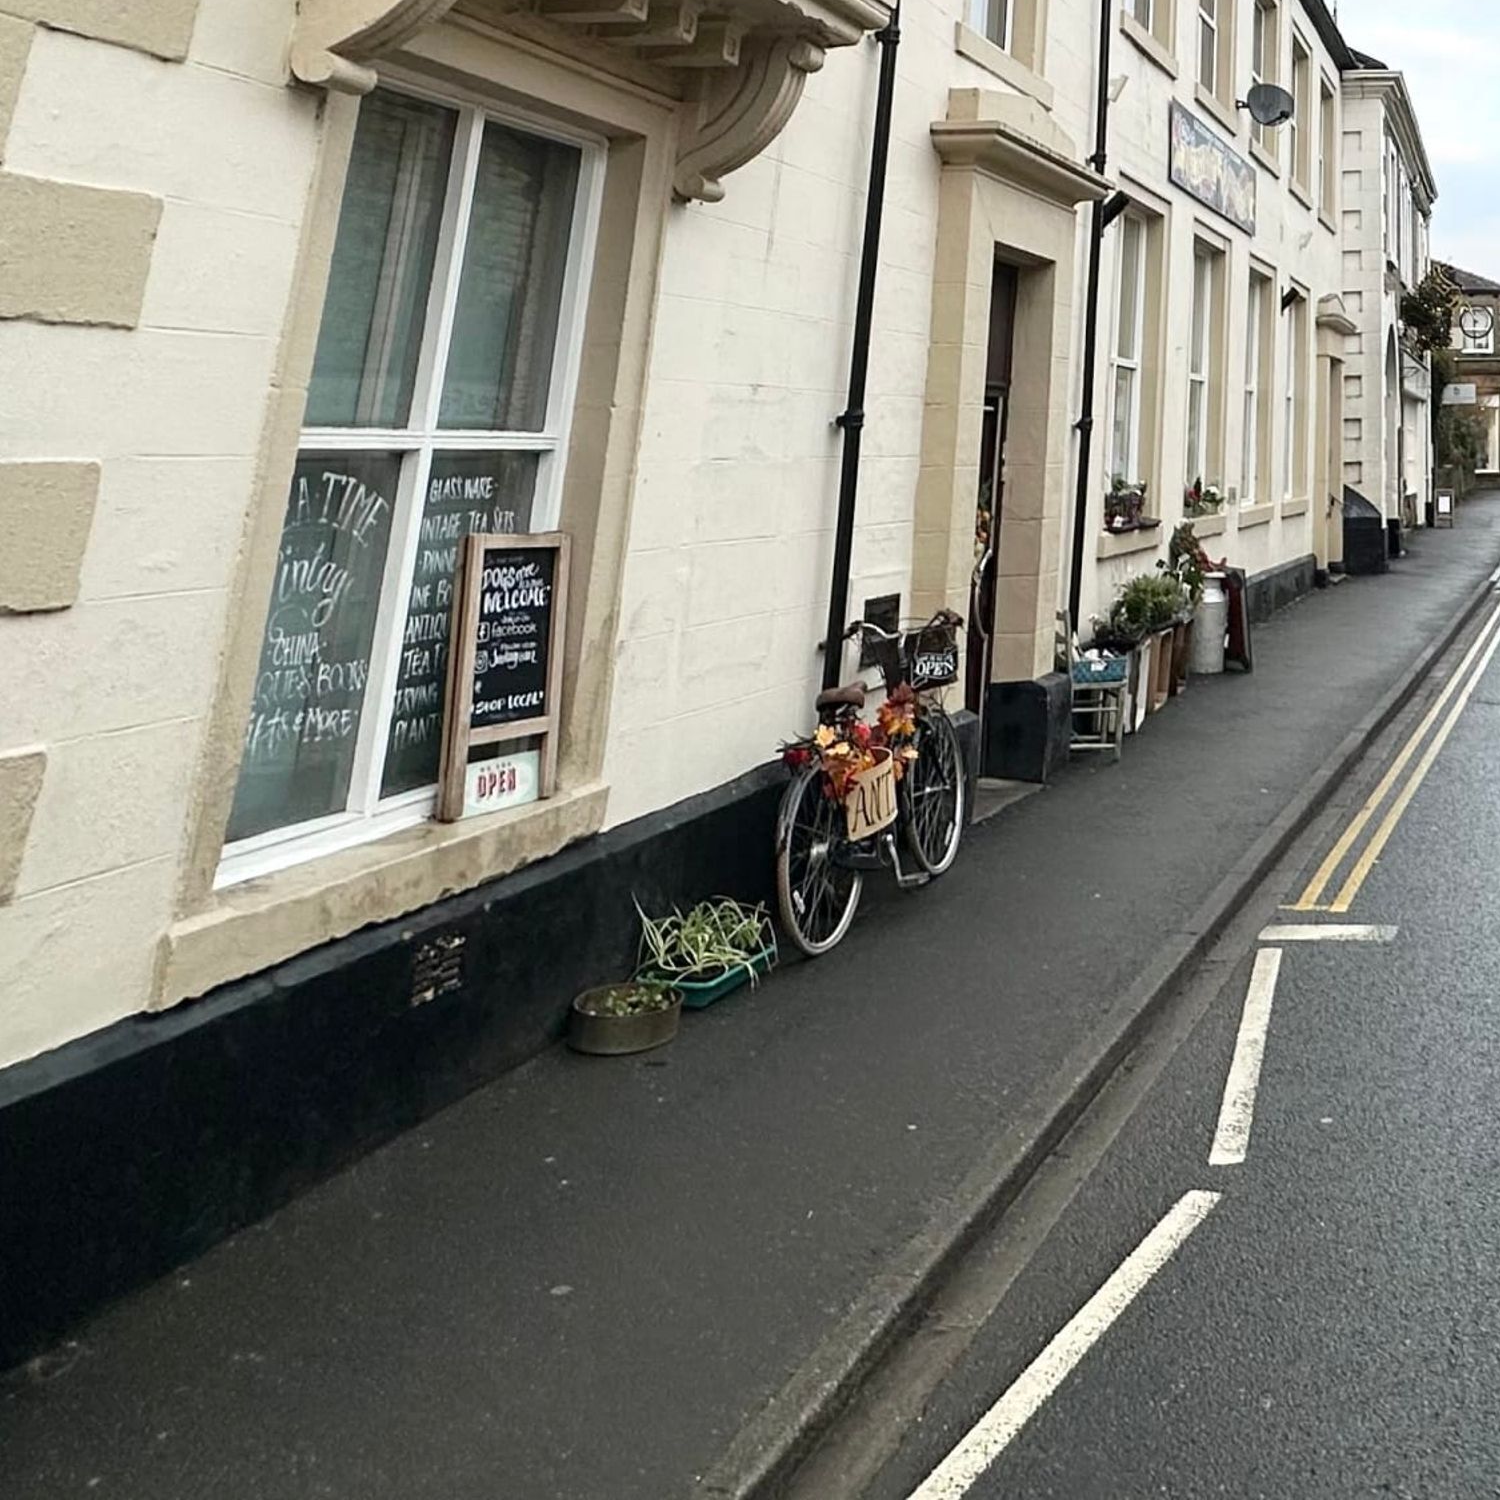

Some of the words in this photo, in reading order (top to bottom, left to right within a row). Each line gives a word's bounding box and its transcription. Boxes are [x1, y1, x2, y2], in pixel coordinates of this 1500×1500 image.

[322, 471, 389, 548] TIME
[468, 509, 488, 533] TEA
[483, 586, 546, 614] WELCOME
[914, 654, 954, 676] OPEN
[477, 767, 516, 799] OPEN
